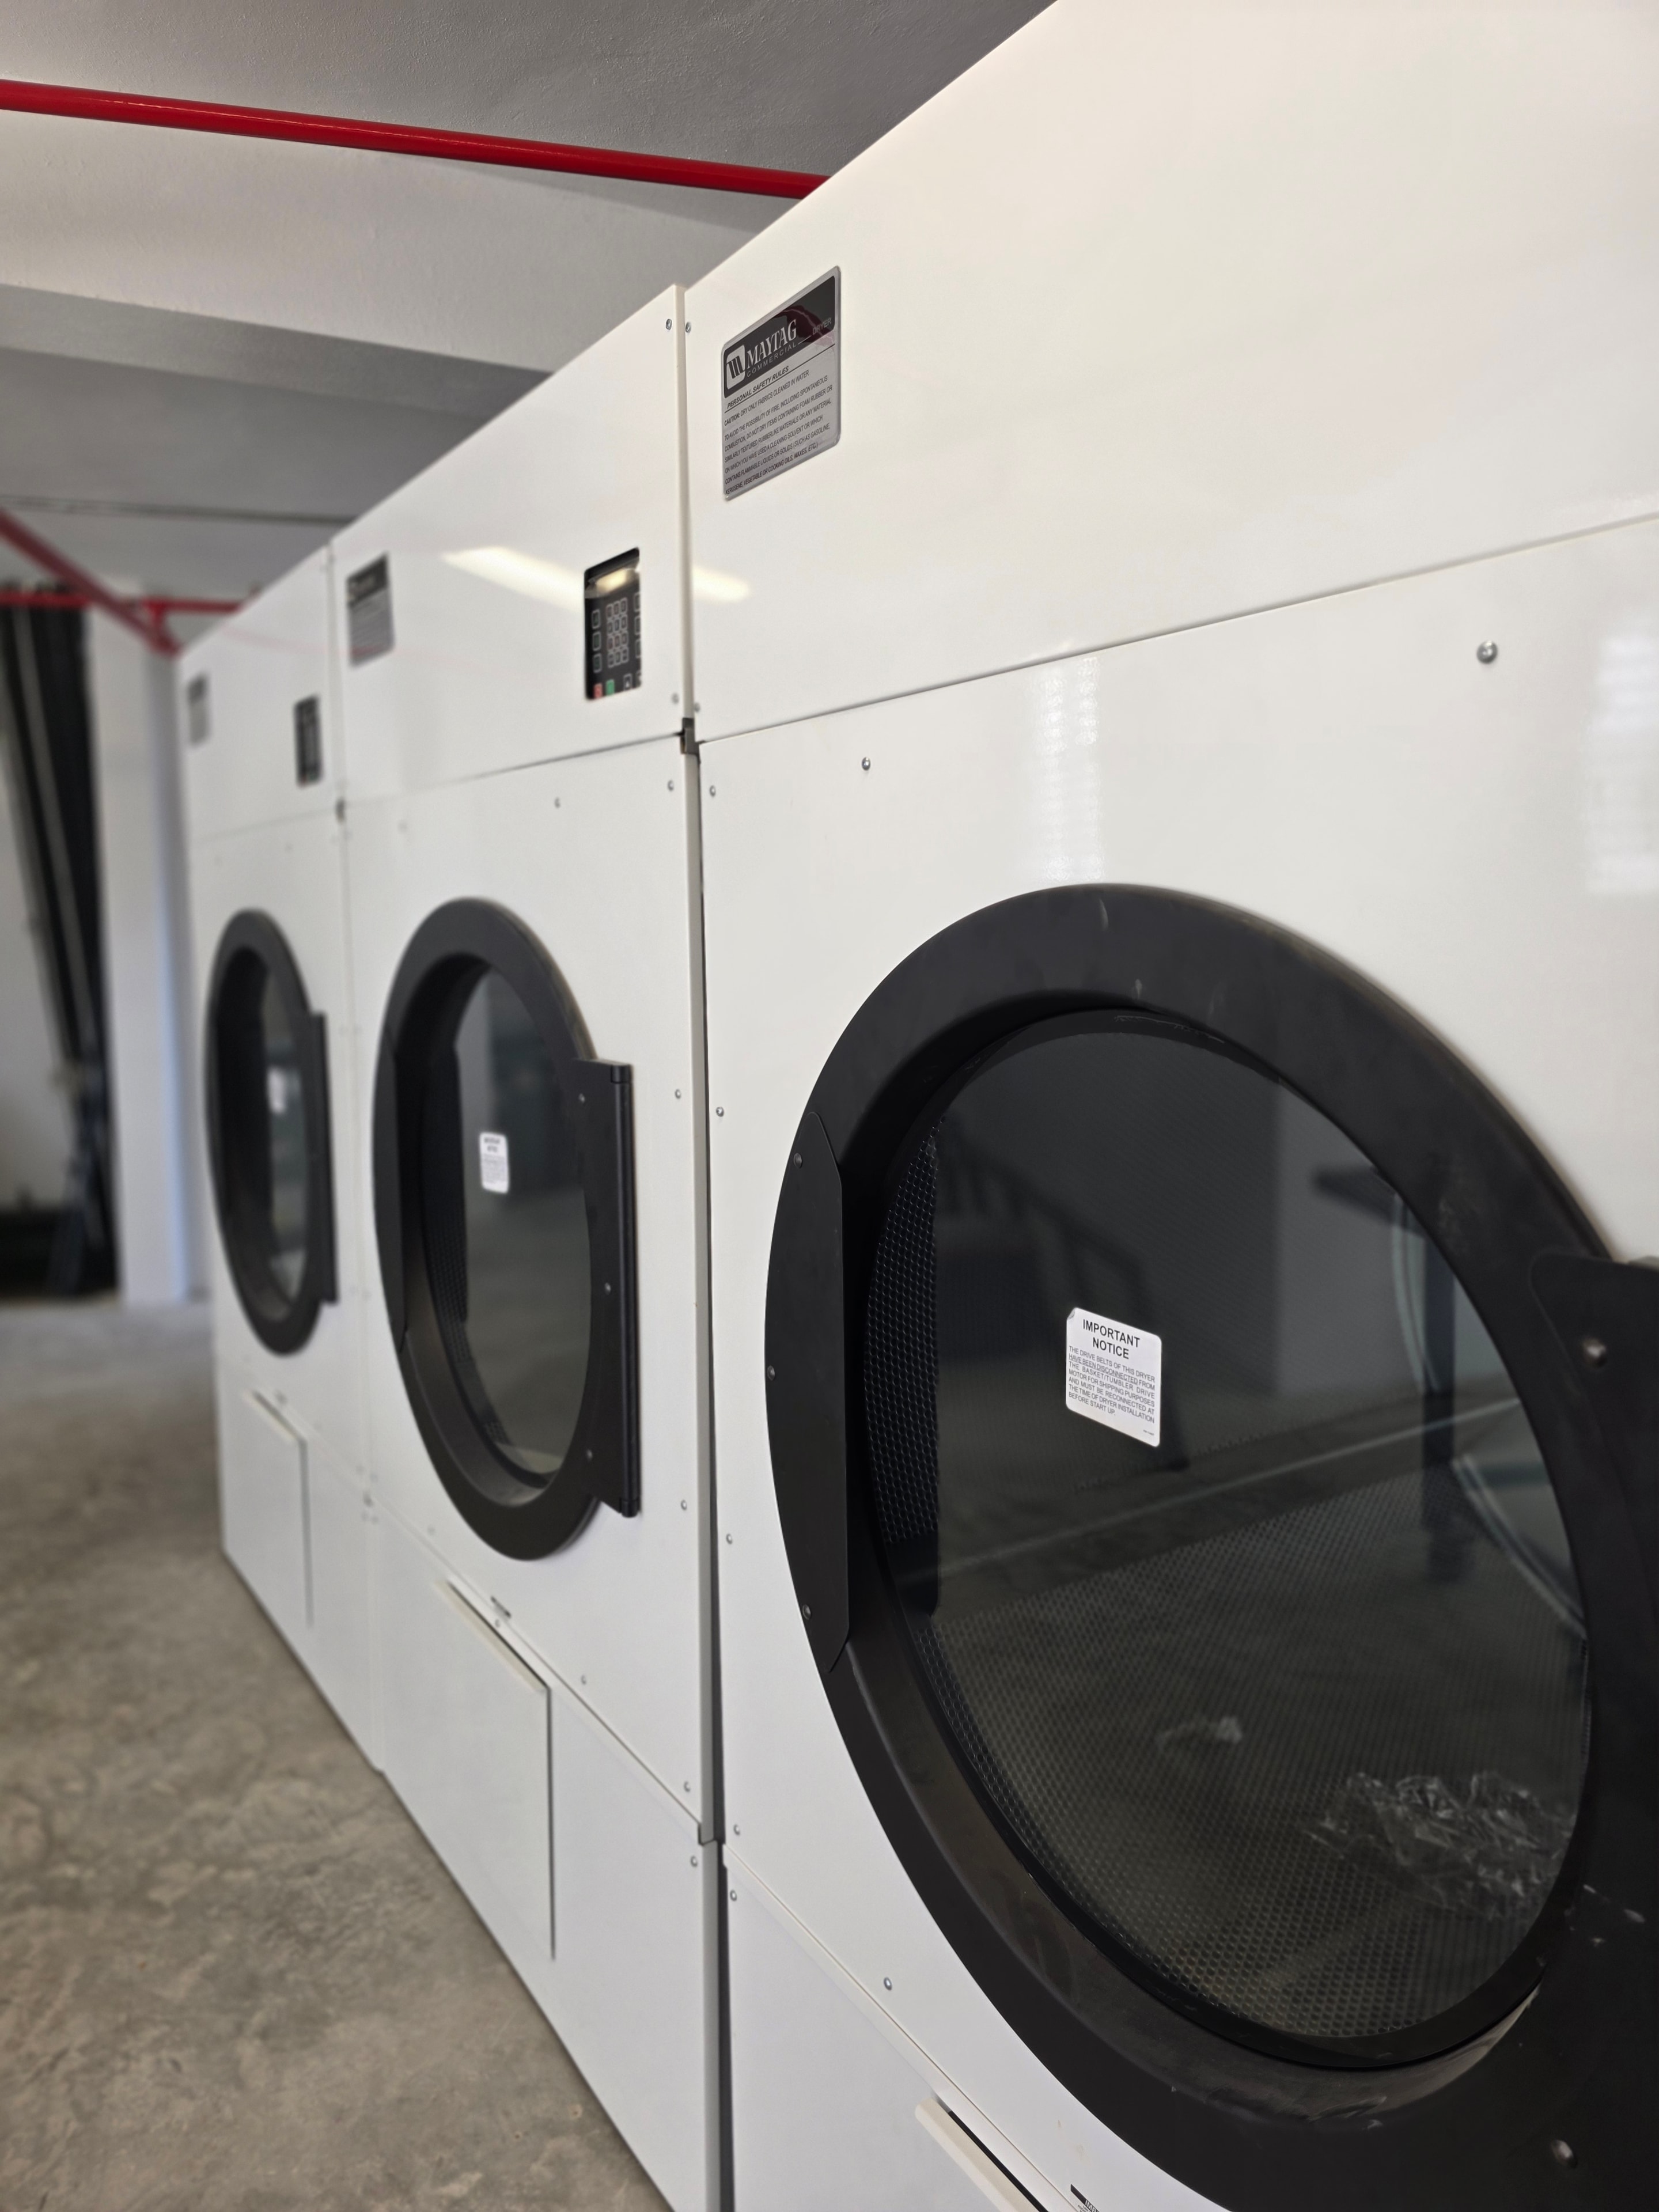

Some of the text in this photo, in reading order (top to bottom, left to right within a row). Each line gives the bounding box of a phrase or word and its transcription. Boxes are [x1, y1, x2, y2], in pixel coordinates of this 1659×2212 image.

[747, 319, 797, 369] MAYTAG
[747, 317, 832, 378] COMMERCIAL DRYER
[727, 365, 789, 409] PERSONAL SAFETY RULES
[729, 428, 738, 438] AVOID
[745, 411, 766, 428] POSSIBILITY
[766, 408, 771, 416] OF
[781, 392, 800, 407] INCLUDING
[800, 375, 828, 396] SPONTANEOUS
[740, 407, 748, 416] DRY
[748, 401, 757, 411] ONLY
[757, 392, 772, 405] FABRICS
[773, 381, 791, 396] CLEANED
[791, 378, 796, 386] IN
[795, 369, 809, 382] WATER
[767, 416, 778, 427] ITEMS
[777, 404, 800, 421] CONTAINING
[799, 397, 810, 409] FOAM
[810, 388, 826, 403] RUBBER
[826, 384, 833, 393] OR
[725, 449, 741, 463] SIMILARLY
[741, 440, 758, 453] TEXTURED
[779, 416, 799, 432] MATERIALS
[805, 407, 813, 417] ANY
[813, 397, 832, 413] MATERIAL
[730, 460, 741, 471] WHICH
[748, 451, 757, 461] HAVE
[757, 445, 767, 456] USED
[770, 434, 787, 449] CLEANING
[787, 425, 804, 439] SOLVENT
[804, 421, 810, 430] OR
[810, 414, 823, 426] WHICH
[725, 471, 741, 484] CONTAINS
[741, 460, 760, 476] FLAMMABLE
[760, 453, 774, 465] LIQUIDS
[774, 449, 780, 458] OR
[779, 442, 793, 455] SOLIDS
[804, 433, 810, 441] AS
[743, 471, 762, 486] VEGETABLE
[768, 459, 784, 472] COOKING
[1083, 1319, 1140, 1347] IMPORTANT
[1093, 1337, 1129, 1359] NOTICE
[1069, 1345, 1079, 1354] THE
[1080, 1349, 1096, 1361] DRIVE
[1096, 1355, 1112, 1367] BELTS
[1122, 1365, 1134, 1375] THIS
[1135, 1370, 1155, 1382] DRYER
[1069, 1353, 1155, 1390] HAVE BEEN DISCONNECTED FROM
[1069, 1361, 1155, 1399] THE BASKET/TUMBLER DRIVE
[1069, 1368, 1155, 1407] MOTOR FOR SHIPPING PURPOSES
[1069, 1376, 1154, 1415] AND MUST BE RECONNECTED AT
[1069, 1391, 1116, 1416] BEFORE START UP.
[1069, 1384, 1078, 1393] THE
[1079, 1388, 1091, 1398] TIME
[1099, 1395, 1117, 1408] DRYER
[1118, 1403, 1155, 1424] INSTALLATION
